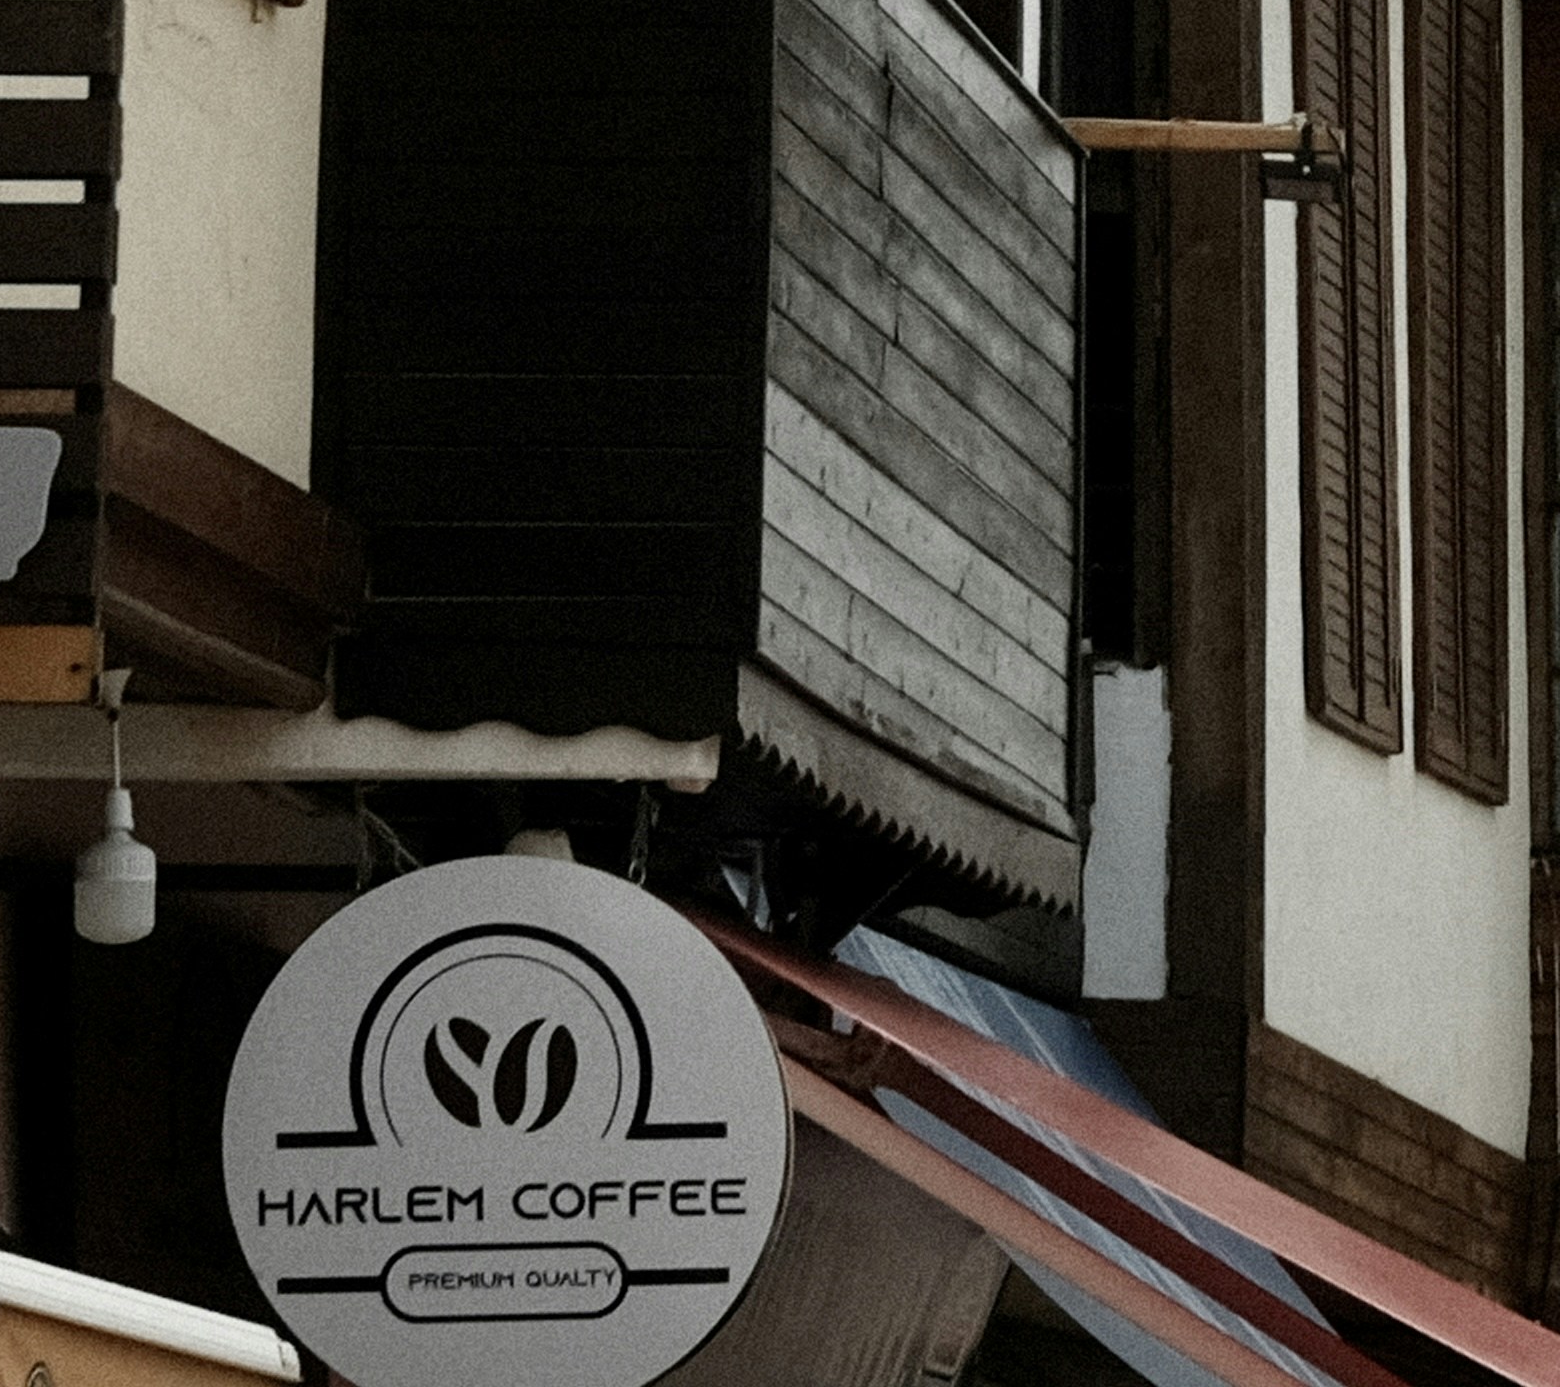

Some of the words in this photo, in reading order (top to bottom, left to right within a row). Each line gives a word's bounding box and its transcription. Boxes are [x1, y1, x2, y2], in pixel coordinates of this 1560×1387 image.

[257, 1185, 485, 1227] HARLEM
[512, 1177, 748, 1220] COFFEE
[407, 1272, 515, 1290] PREMIUM
